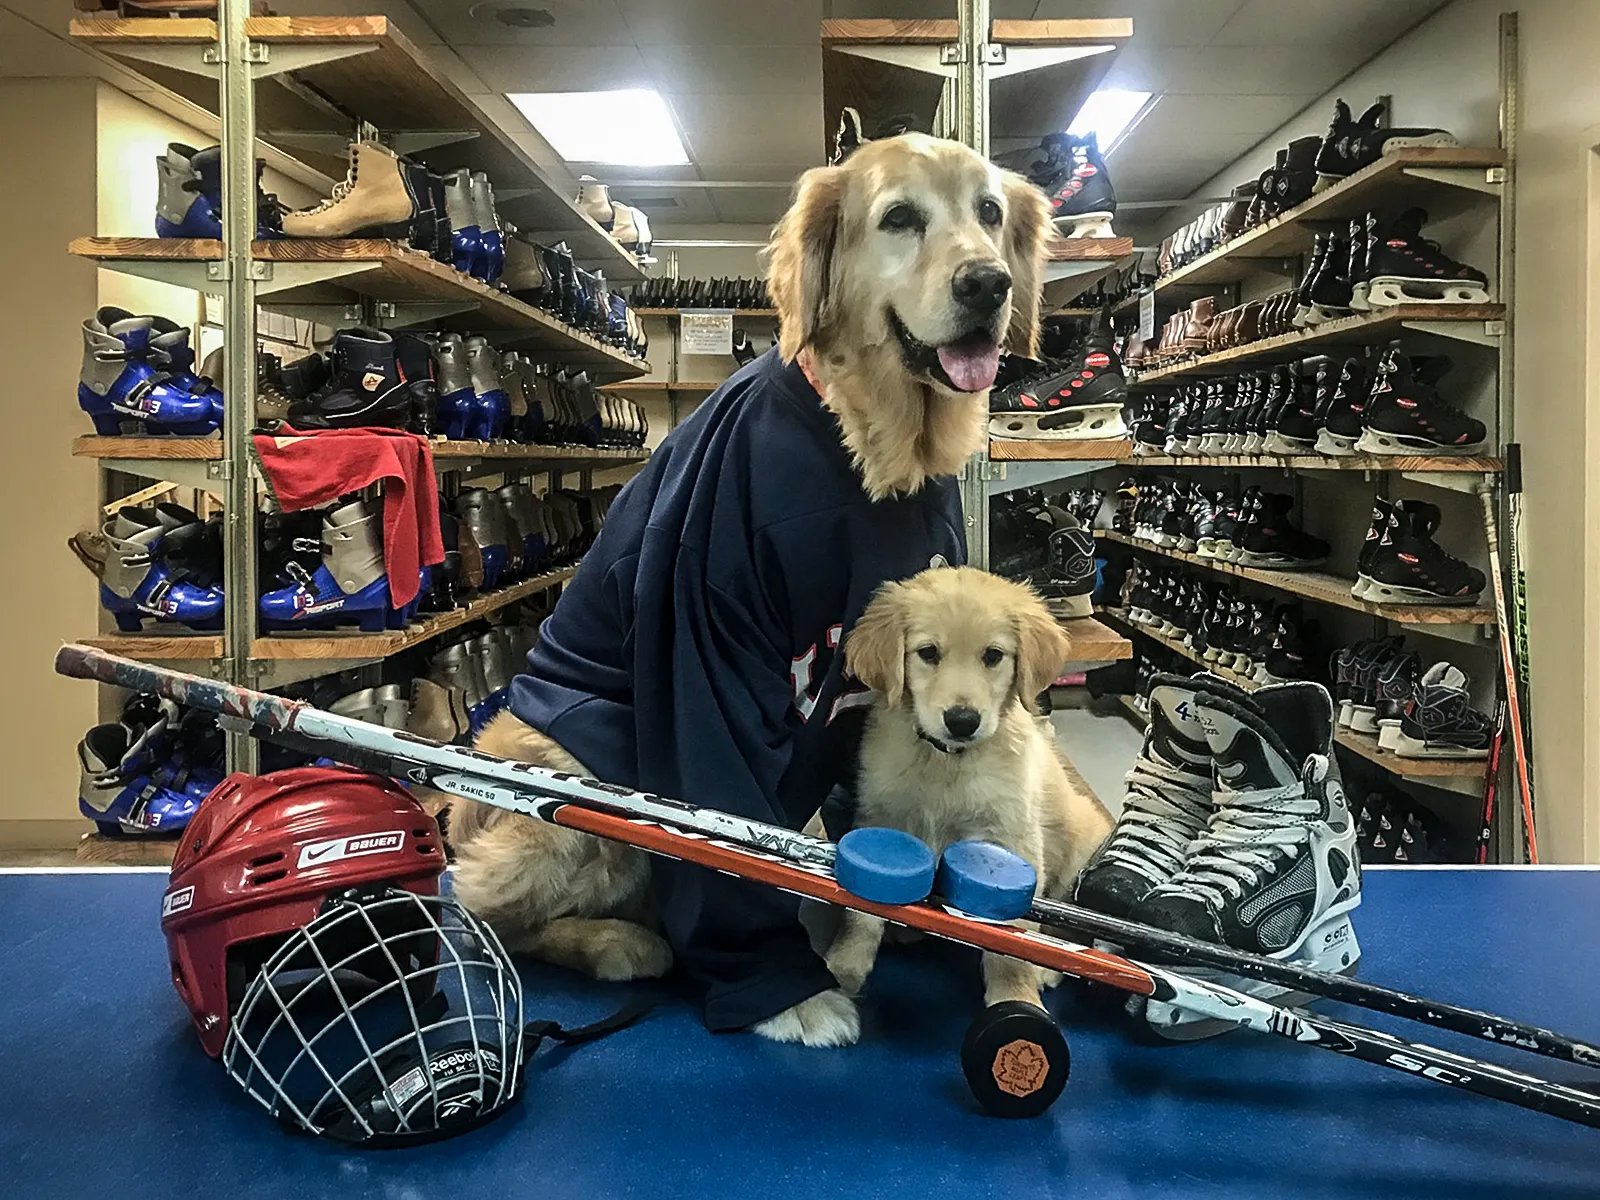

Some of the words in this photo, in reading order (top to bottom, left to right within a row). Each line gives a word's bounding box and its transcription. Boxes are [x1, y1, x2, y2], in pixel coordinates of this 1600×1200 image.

[293, 593, 315, 609] 103
[1518, 570, 1529, 684] HESPELER
[460, 784, 484, 797] SAKIC
[485, 791, 496, 801] 50
[349, 836, 397, 851] BAUER
